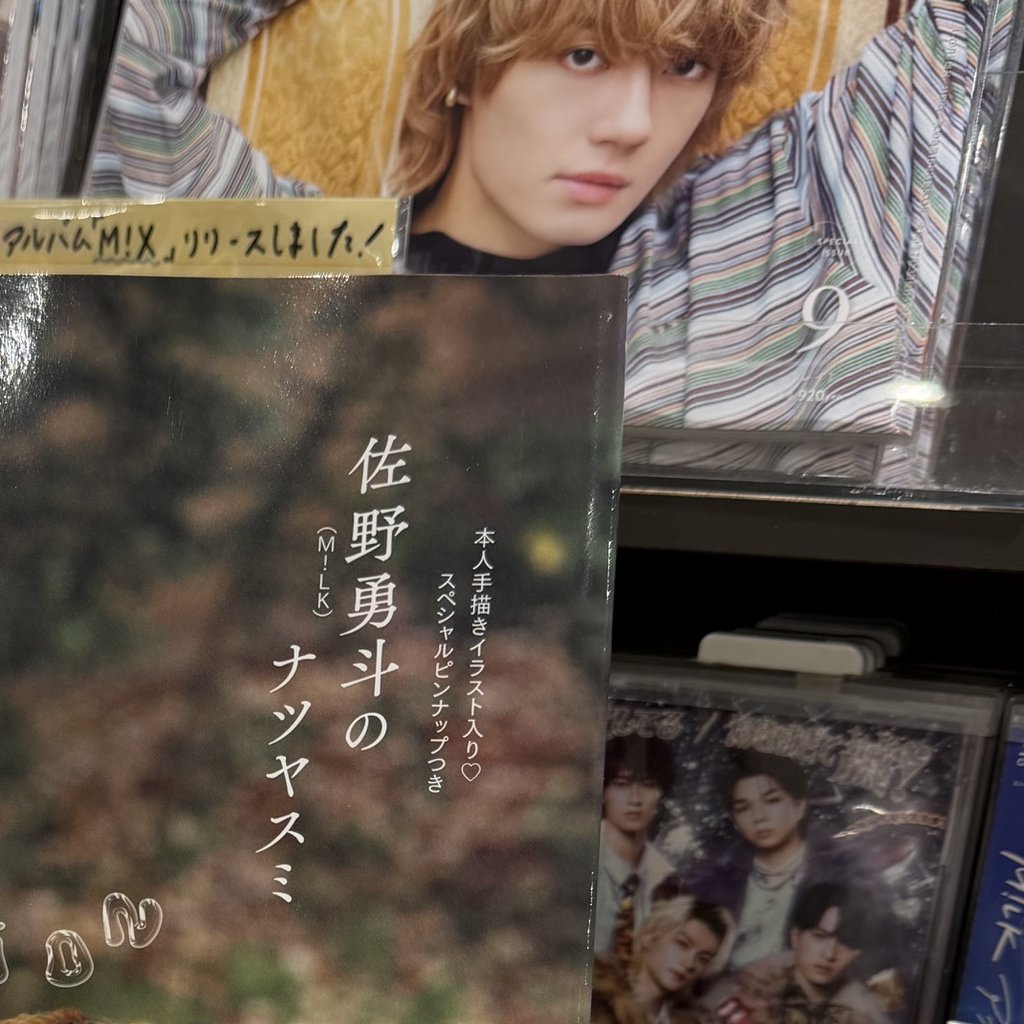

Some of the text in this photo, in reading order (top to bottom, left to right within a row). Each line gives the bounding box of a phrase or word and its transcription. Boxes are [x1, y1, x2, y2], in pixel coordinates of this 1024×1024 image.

[796, 285, 850, 354] 9
[339, 434, 413, 751] 佐野勇斗の
[427, 572, 456, 794] スペシャルピンナップつき
[255, 644, 317, 903] ナツヤスミ
